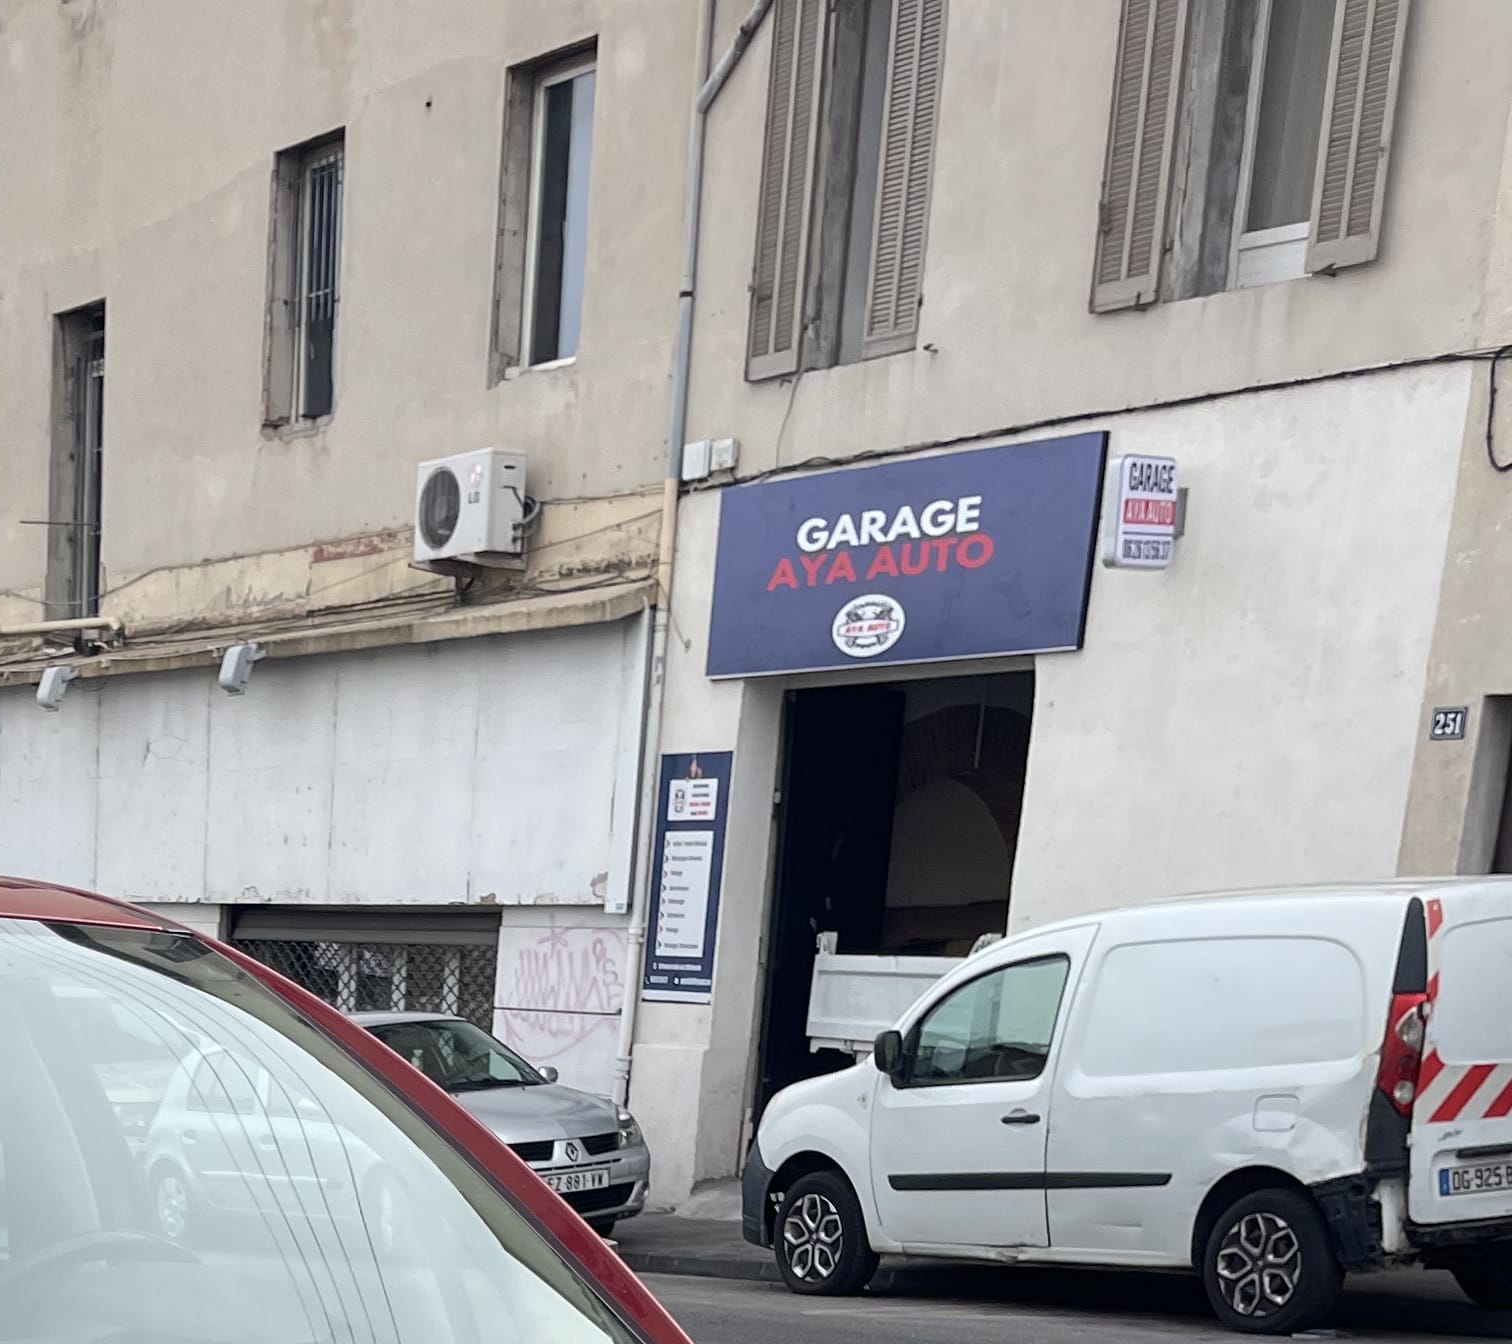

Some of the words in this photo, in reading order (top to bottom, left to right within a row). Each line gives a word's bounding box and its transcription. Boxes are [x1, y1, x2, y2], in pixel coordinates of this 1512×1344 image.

[1129, 462, 1175, 494] GARAGE
[796, 496, 982, 552] GARAGE
[1126, 500, 1146, 520] AYA
[1147, 501, 1174, 524] AUTO
[766, 550, 857, 591] AYA
[866, 533, 995, 580] AUTO
[1434, 712, 1462, 734] 251
